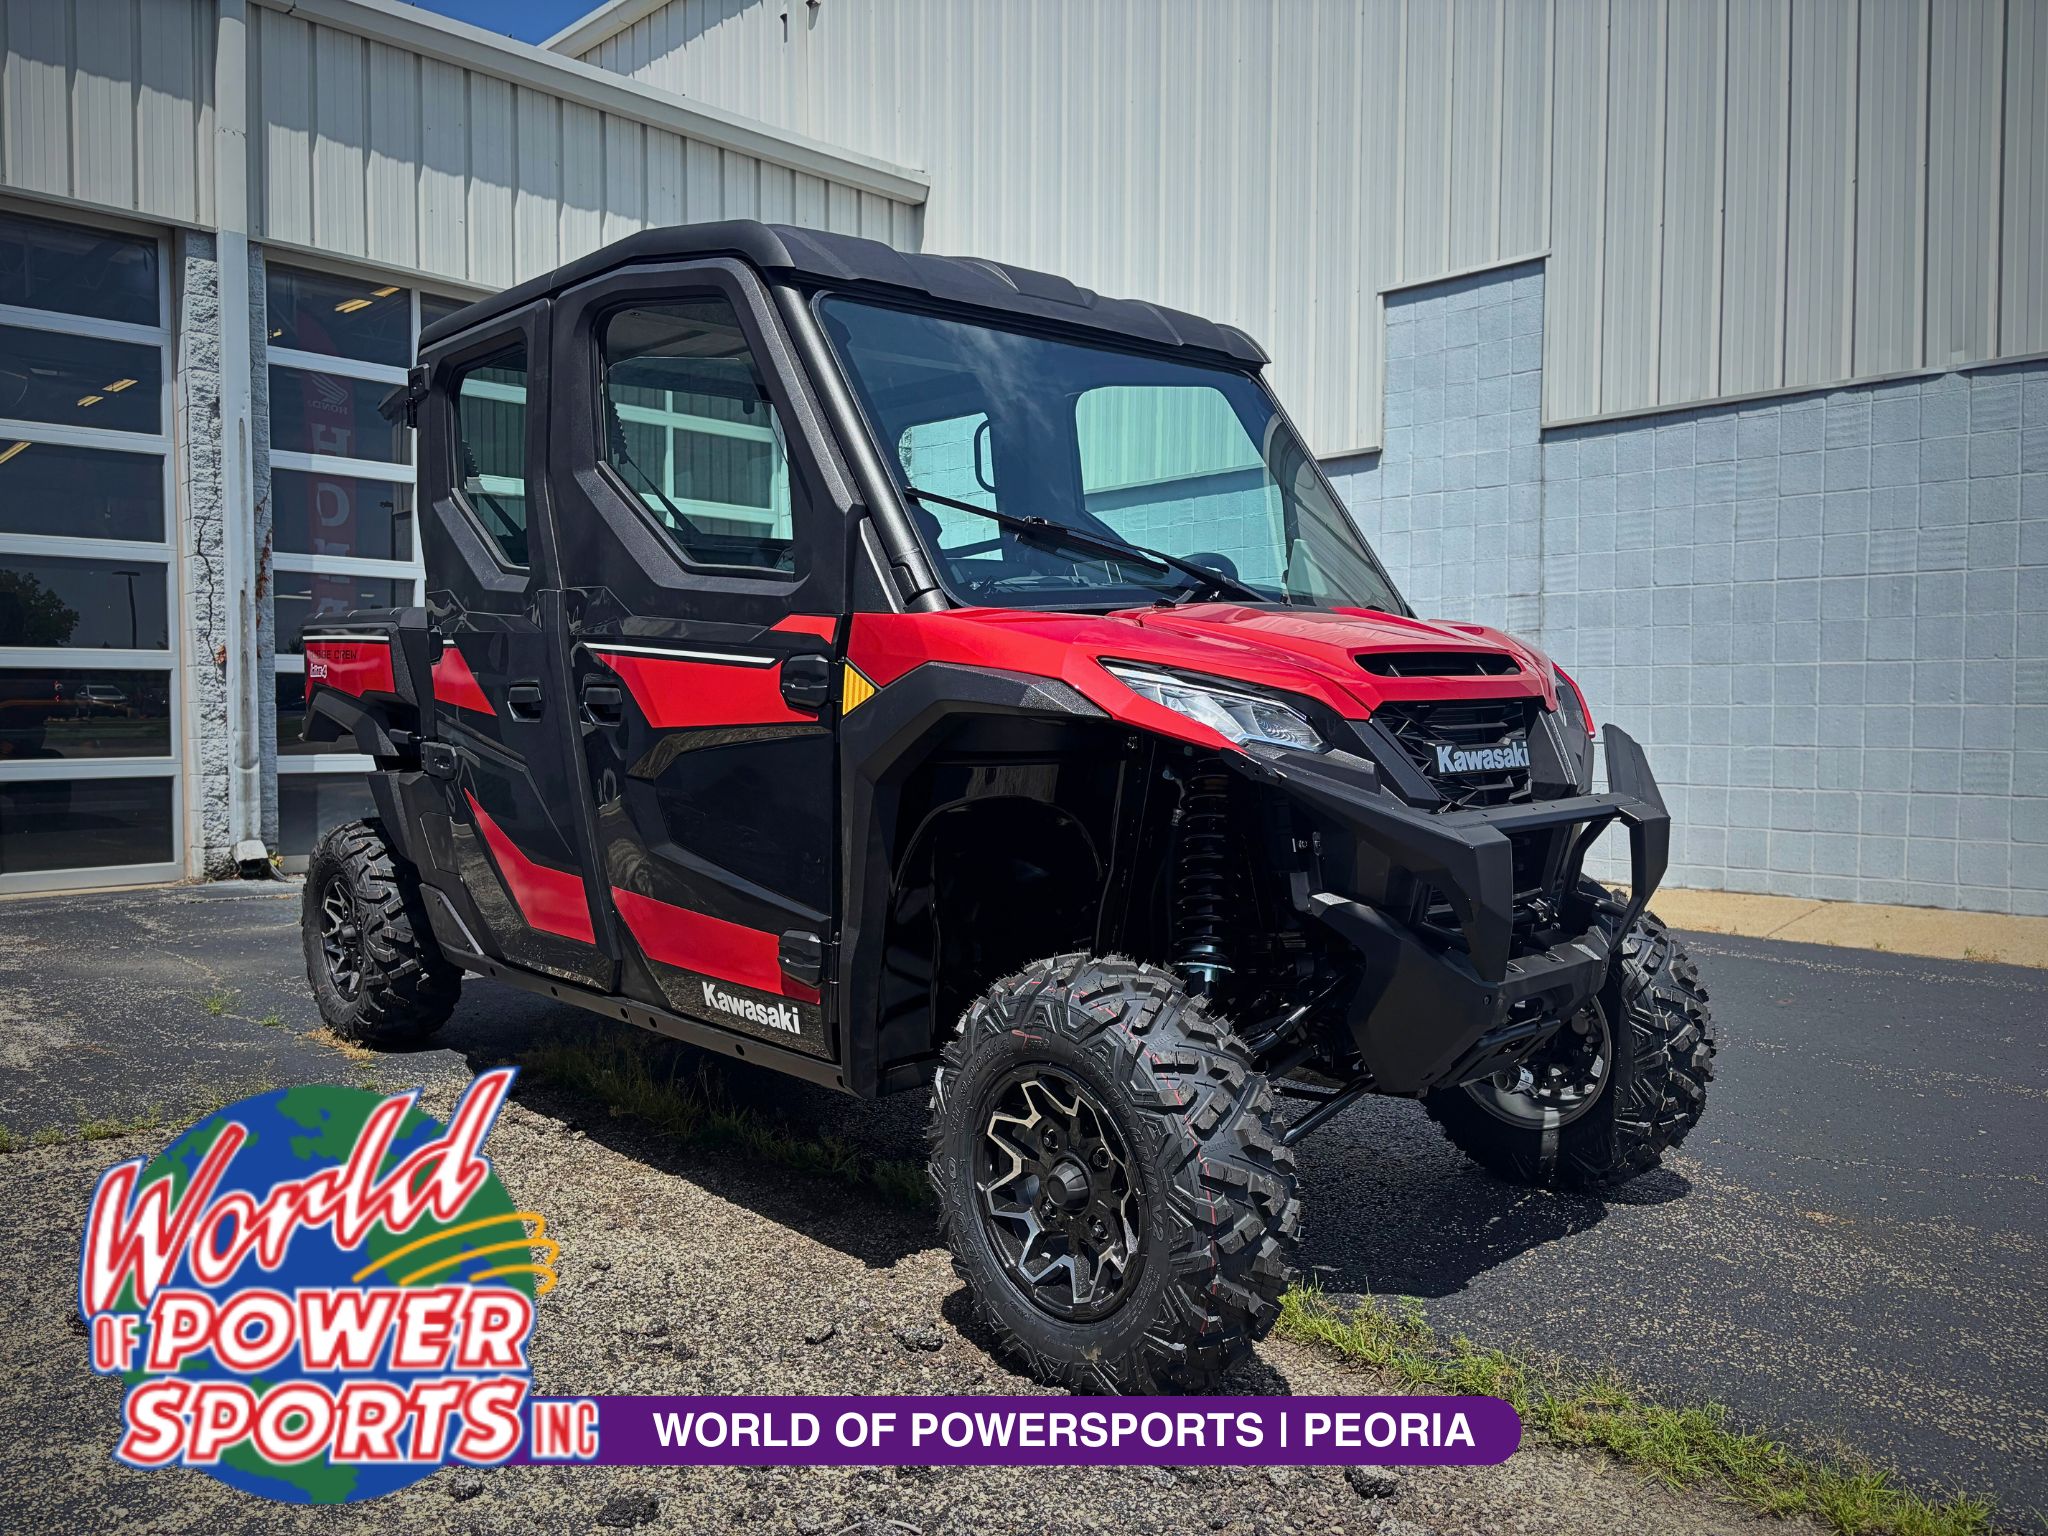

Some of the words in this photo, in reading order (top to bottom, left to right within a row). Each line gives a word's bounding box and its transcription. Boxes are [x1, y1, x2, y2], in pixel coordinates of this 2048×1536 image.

[334, 649, 358, 660] CREW
[1436, 741, 1531, 774] Kawasaki
[702, 981, 801, 1035] Kawasaki
